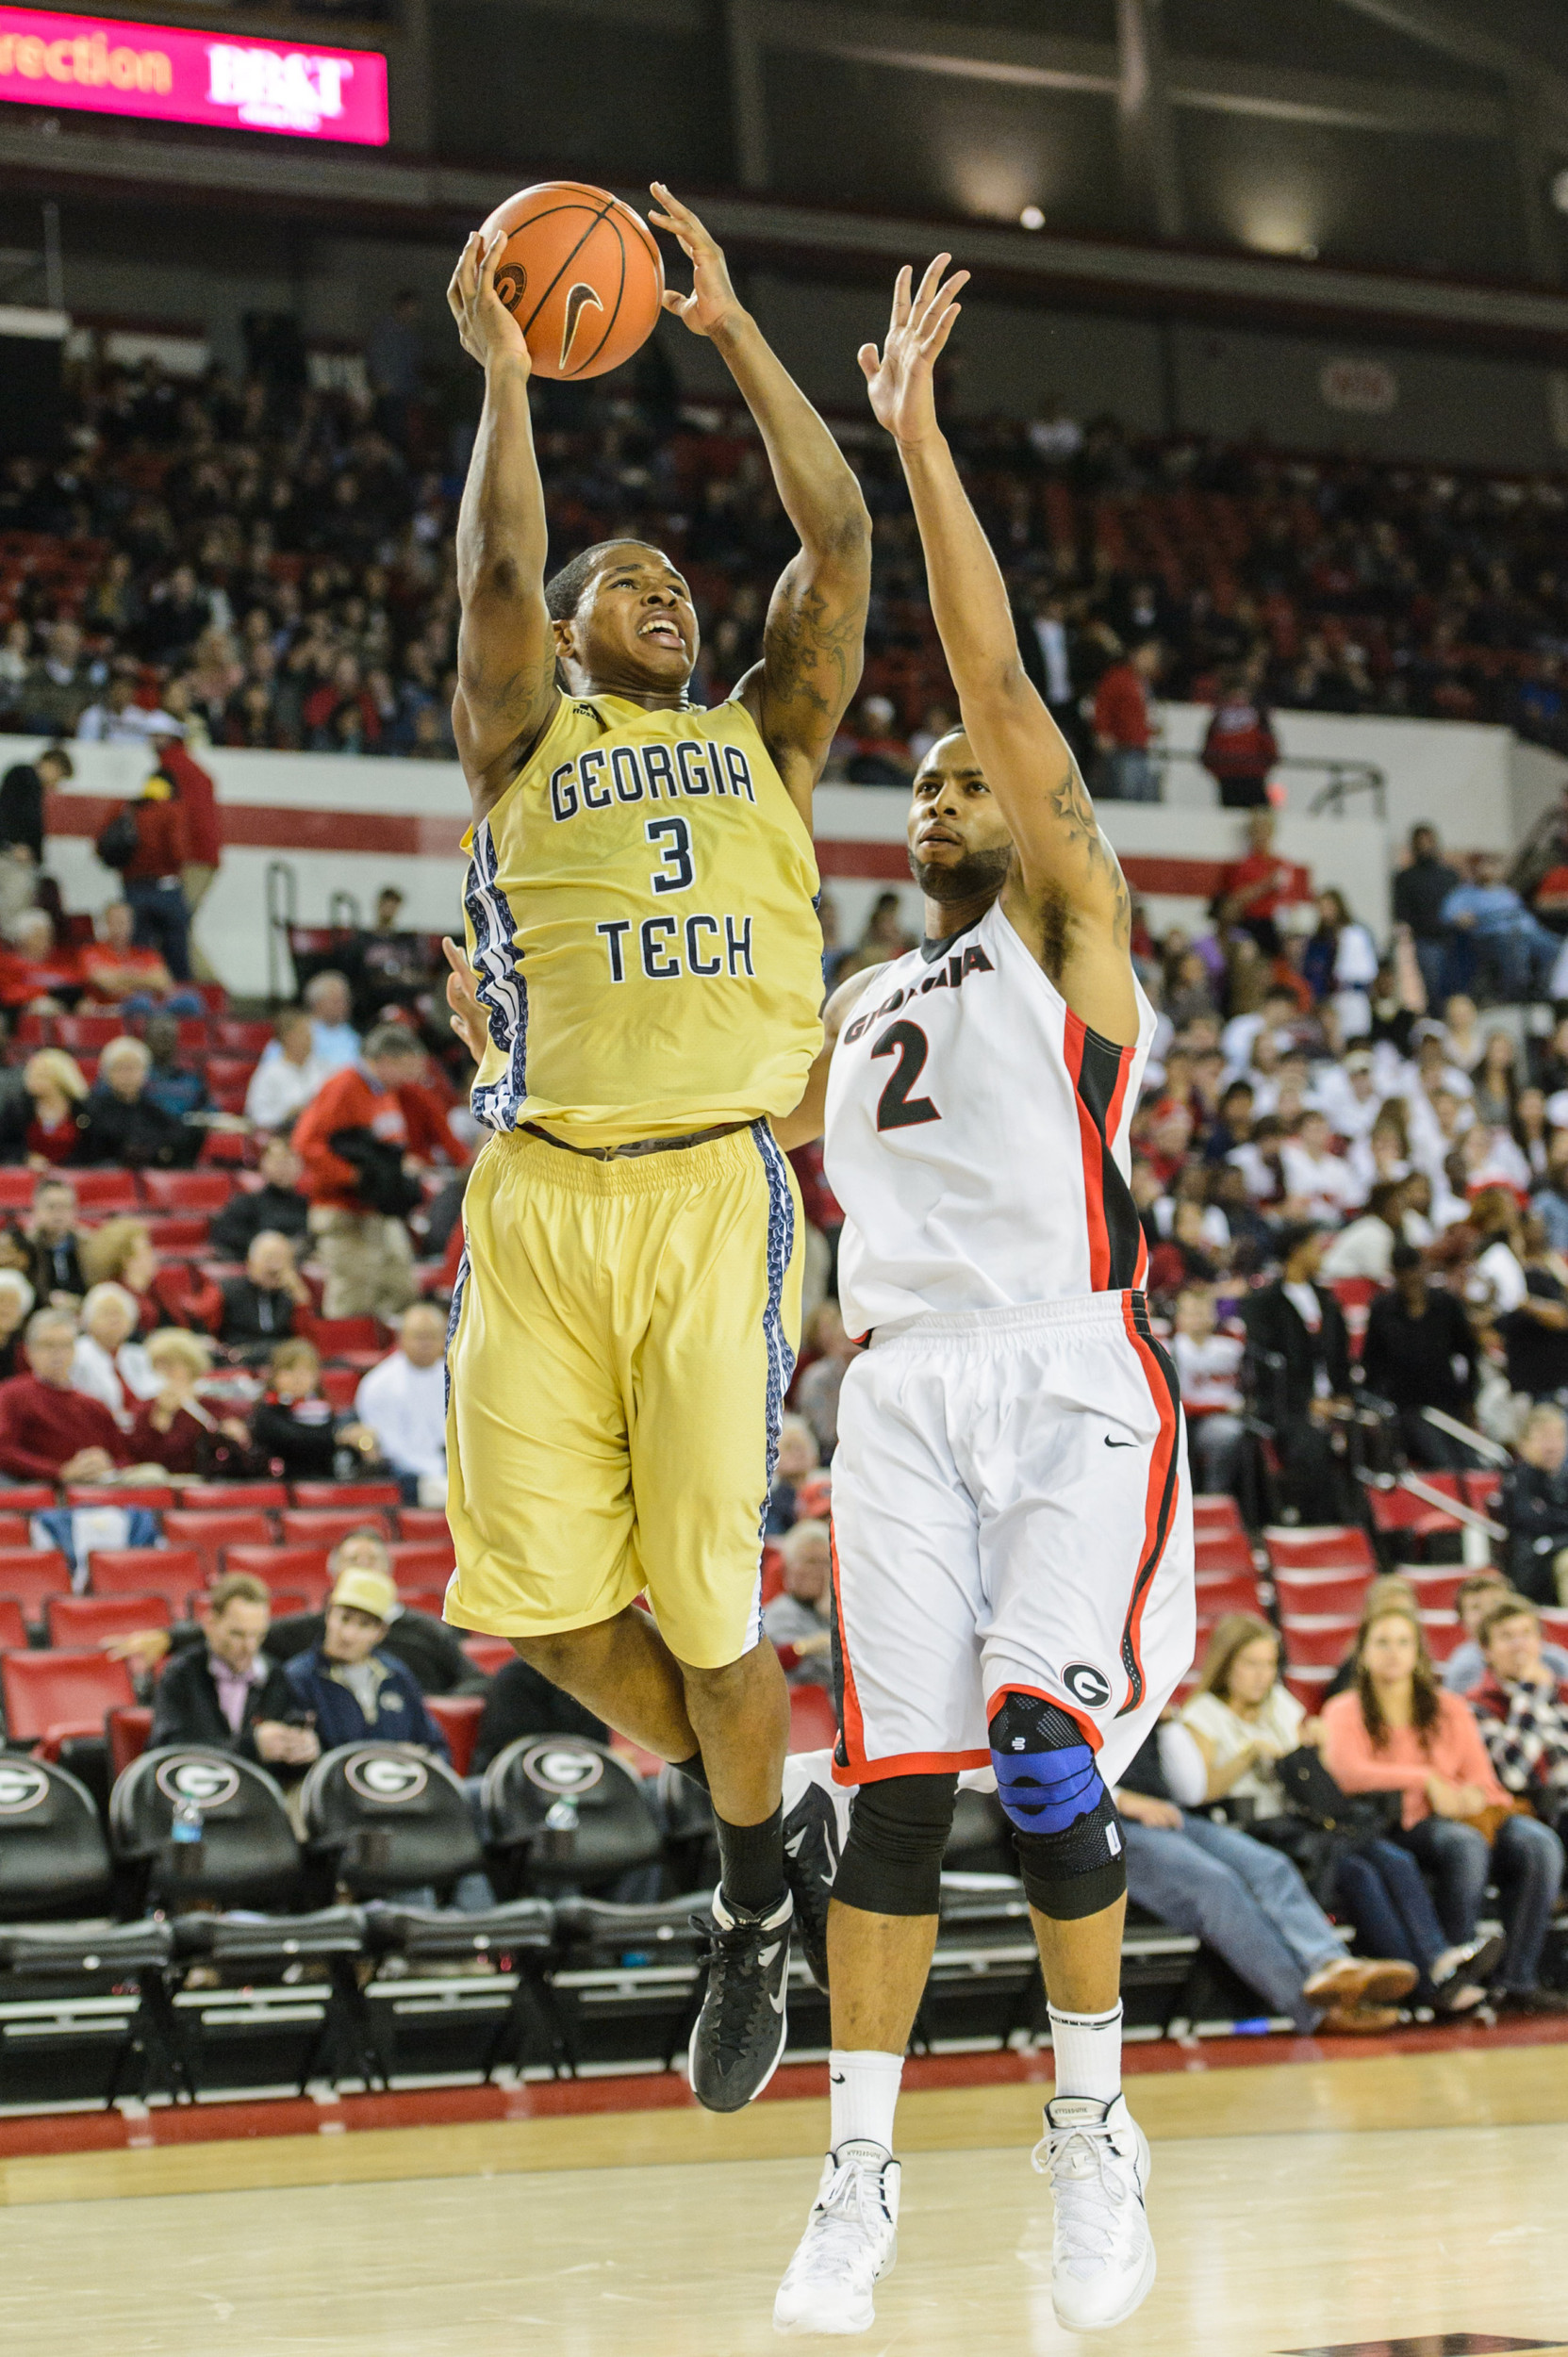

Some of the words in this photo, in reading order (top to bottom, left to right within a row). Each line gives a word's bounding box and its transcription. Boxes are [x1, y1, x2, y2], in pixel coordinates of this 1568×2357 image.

[550, 741, 757, 823] GEORGIA
[644, 815, 697, 897] 3
[595, 914, 757, 983] TECH
[844, 944, 996, 1045] GOIA
[870, 1019, 942, 1132] 2
[1063, 1663, 1111, 1707] G
[164, 1760, 234, 1801] G
[353, 1755, 421, 1794] G
[532, 1748, 598, 1787] G
